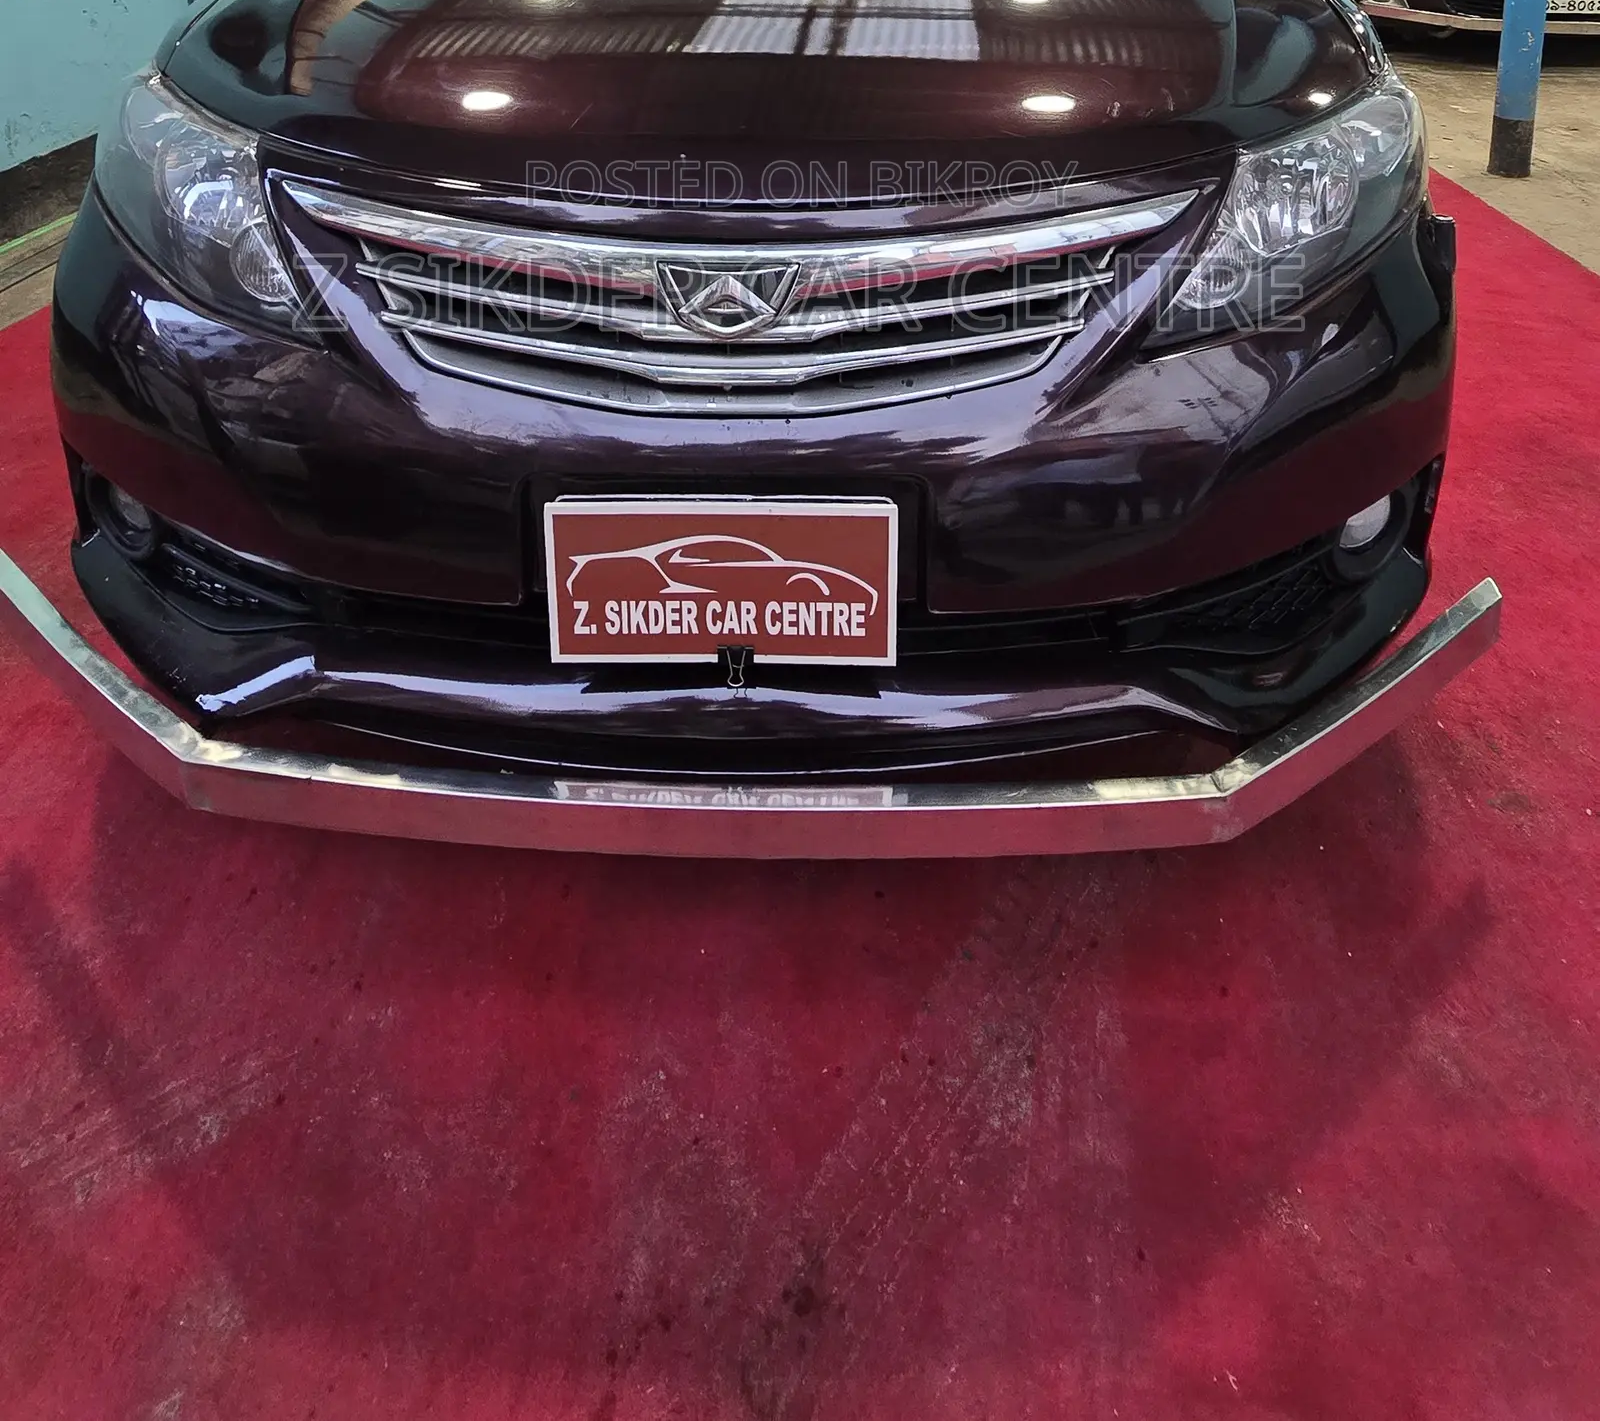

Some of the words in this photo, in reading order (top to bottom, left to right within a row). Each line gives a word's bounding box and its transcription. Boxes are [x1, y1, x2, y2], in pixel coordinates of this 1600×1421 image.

[573, 600, 597, 635] Z.
[604, 600, 699, 635] SIKDER
[705, 601, 758, 635] CAR
[765, 602, 866, 637] CENTRE
